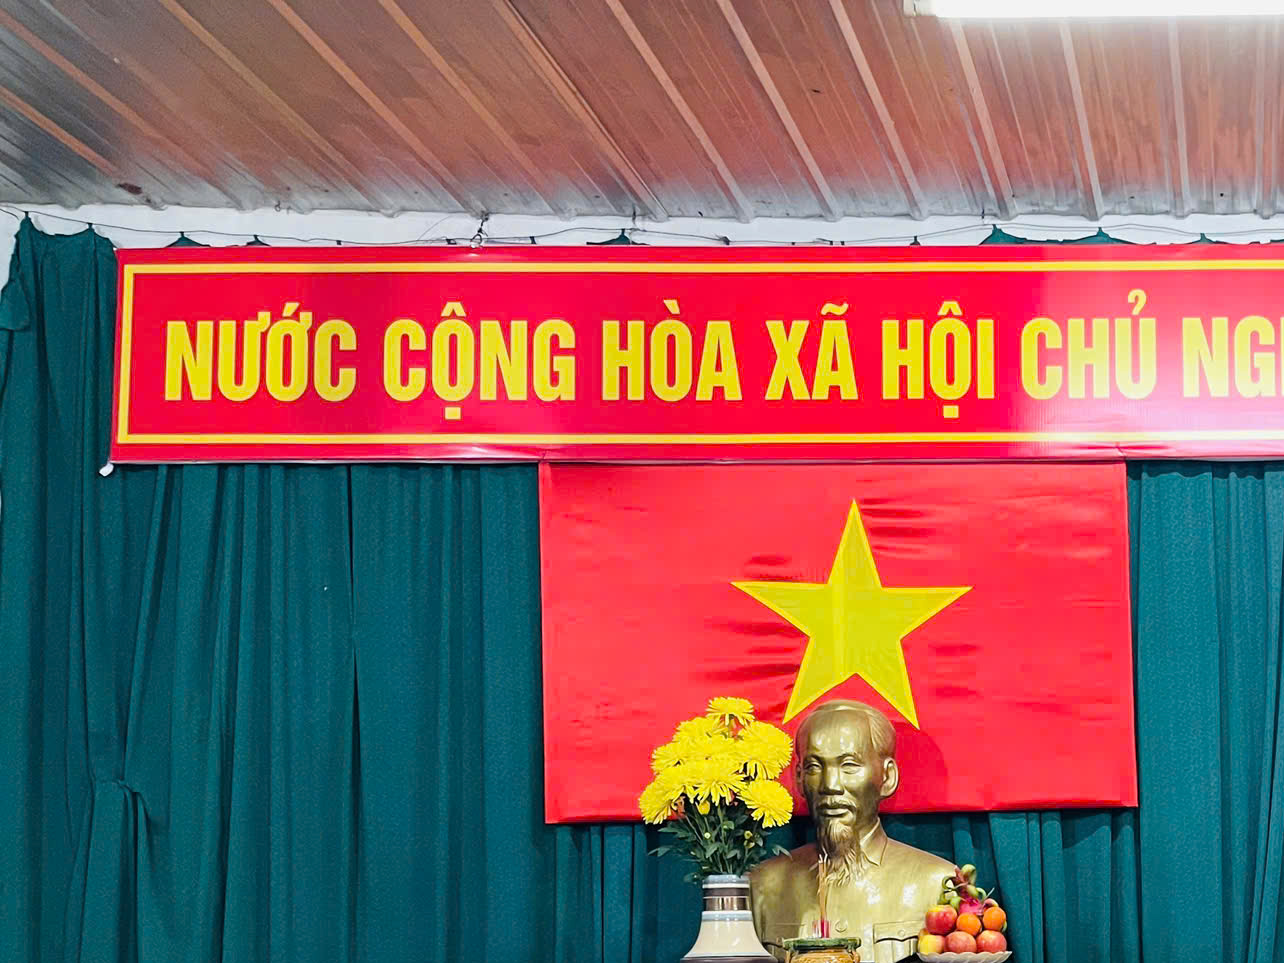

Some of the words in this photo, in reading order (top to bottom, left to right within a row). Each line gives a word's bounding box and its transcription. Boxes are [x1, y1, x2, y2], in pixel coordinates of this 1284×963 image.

[165, 298, 357, 402] NƯỚC
[383, 302, 577, 420] CỘNG
[602, 300, 743, 402] HÒA
[765, 302, 859, 401] XÃ
[882, 301, 995, 419] HỘI
[1021, 288, 1157, 401] CHỦ
